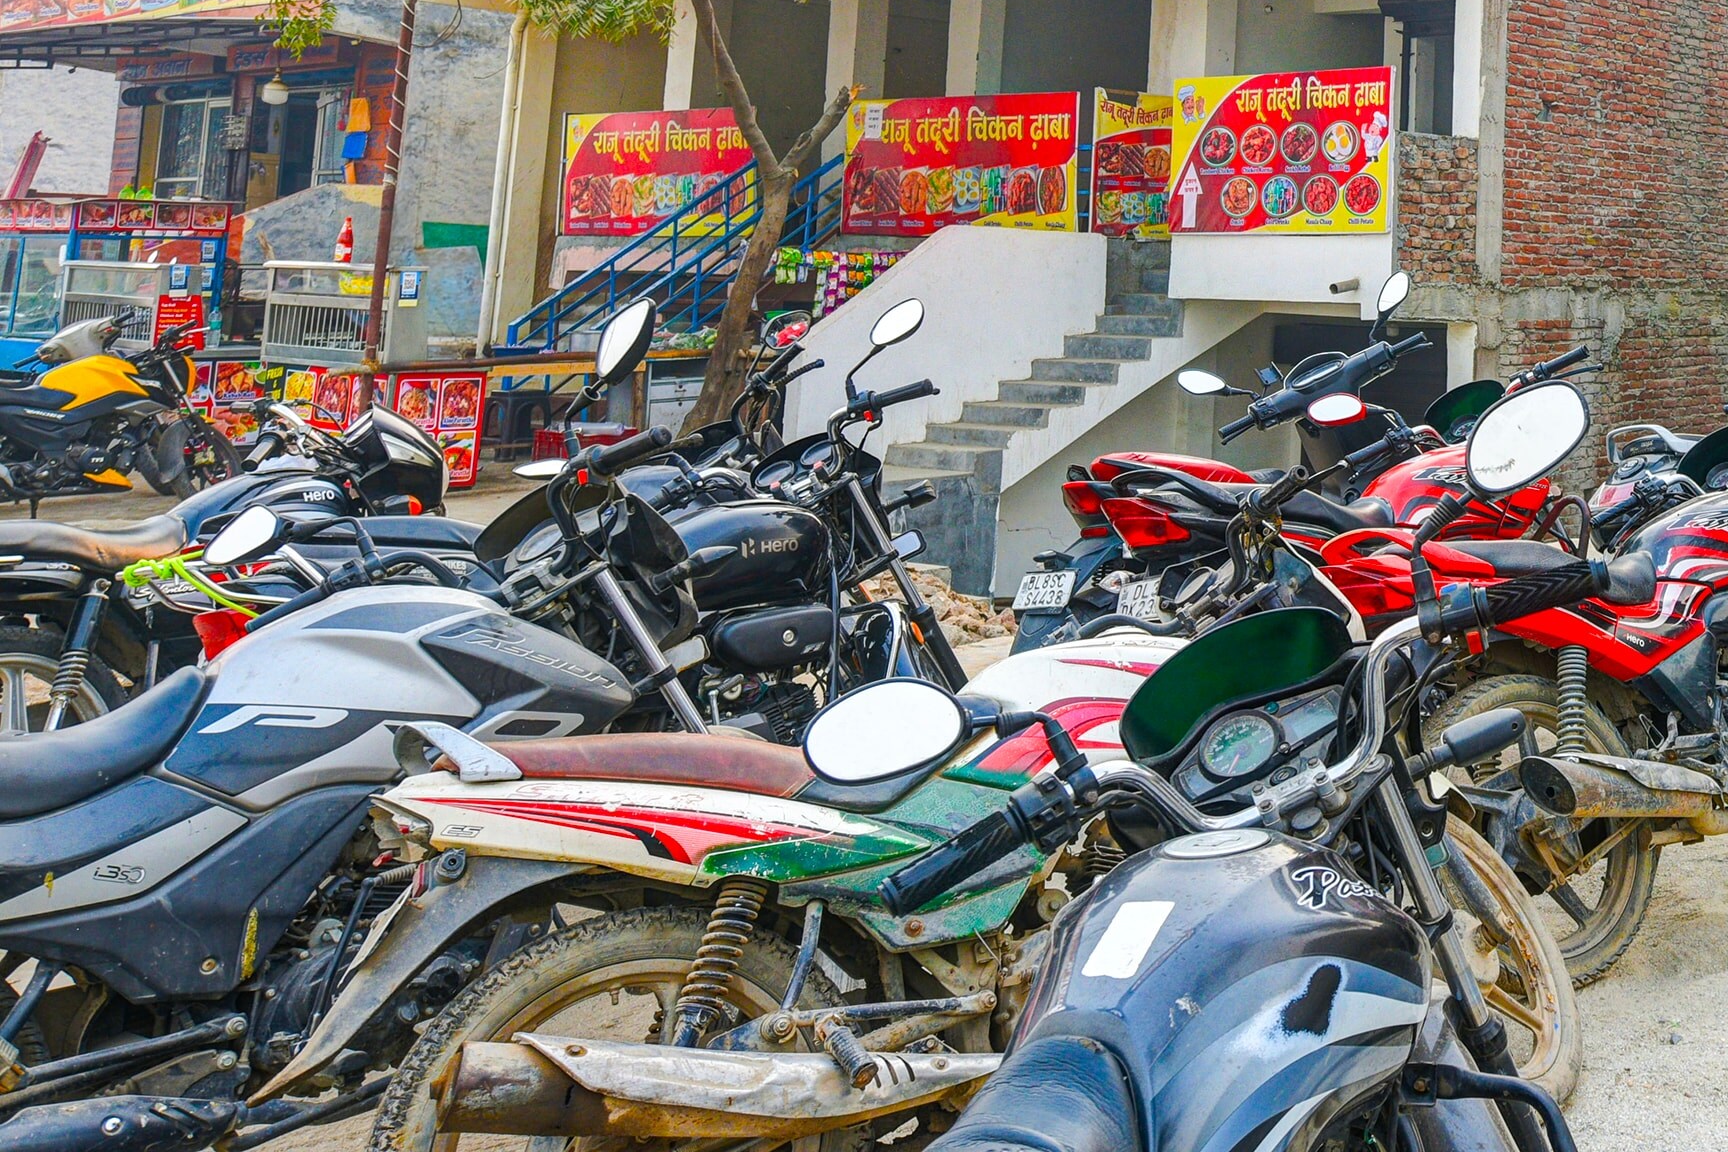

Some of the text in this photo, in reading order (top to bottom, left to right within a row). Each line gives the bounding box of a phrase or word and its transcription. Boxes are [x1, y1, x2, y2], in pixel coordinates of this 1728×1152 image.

[1235, 89, 1267, 123] राजू
[1266, 77, 1302, 122] तंदूरी
[1306, 76, 1351, 110] चिकन
[593, 131, 625, 164] राजू
[623, 119, 660, 163] तंदूरी
[665, 119, 713, 152] चिकन
[916, 106, 960, 155] तंदूरी
[966, 106, 1024, 142] चिकन
[303, 489, 335, 502] Hero
[761, 538, 798, 553] Hero
[1133, 583, 1148, 600] DL
